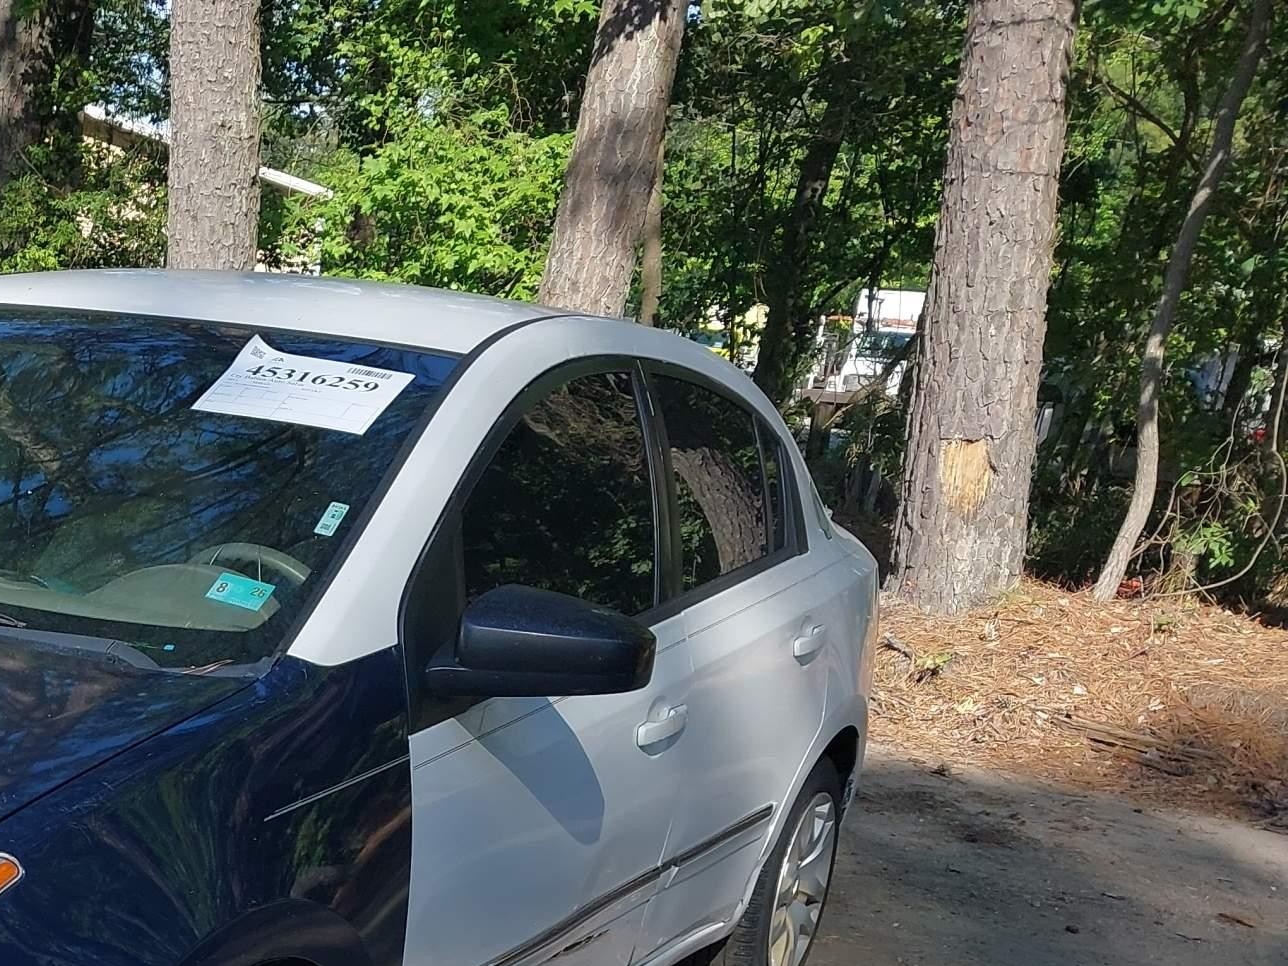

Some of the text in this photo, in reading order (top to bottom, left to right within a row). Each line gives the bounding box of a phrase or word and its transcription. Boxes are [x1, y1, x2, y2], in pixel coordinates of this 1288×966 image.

[245, 364, 381, 393] 45316259
[216, 582, 229, 593] 8
[249, 587, 268, 598] 26
